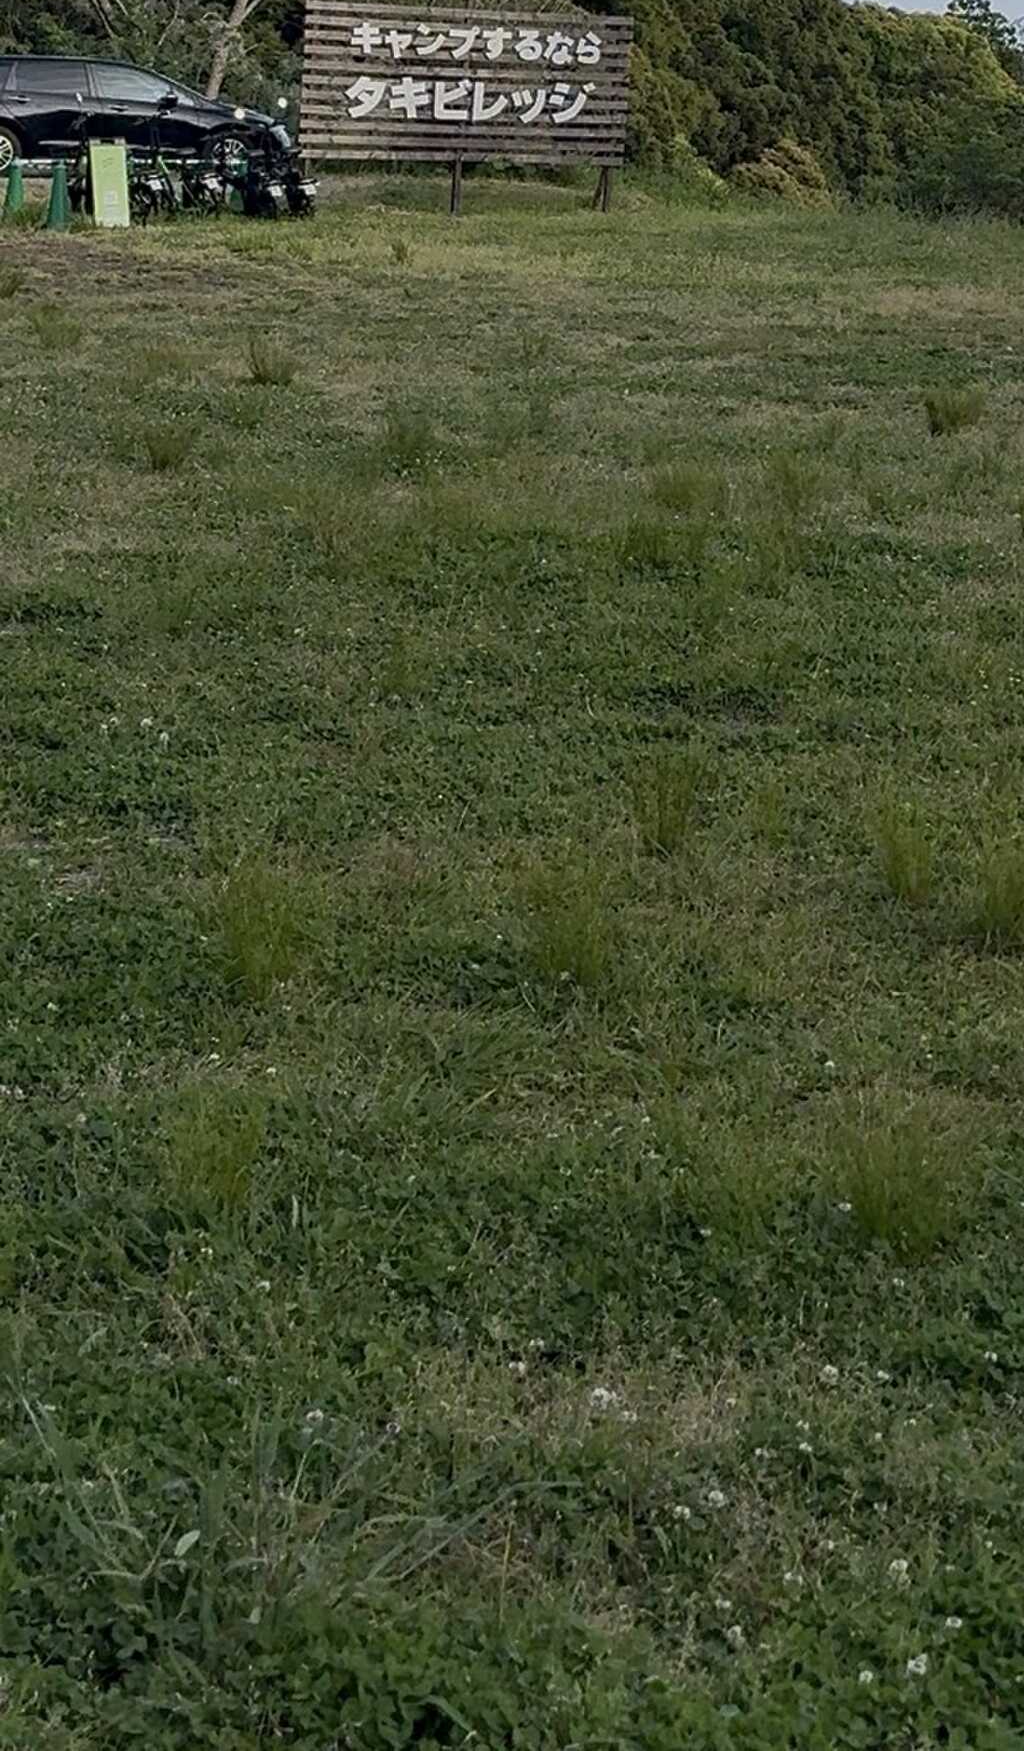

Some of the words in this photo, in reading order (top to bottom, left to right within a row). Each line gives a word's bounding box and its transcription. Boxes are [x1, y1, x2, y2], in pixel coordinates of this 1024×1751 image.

[351, 22, 602, 65] キャンプするなら
[345, 76, 597, 124] タキビレッジ
